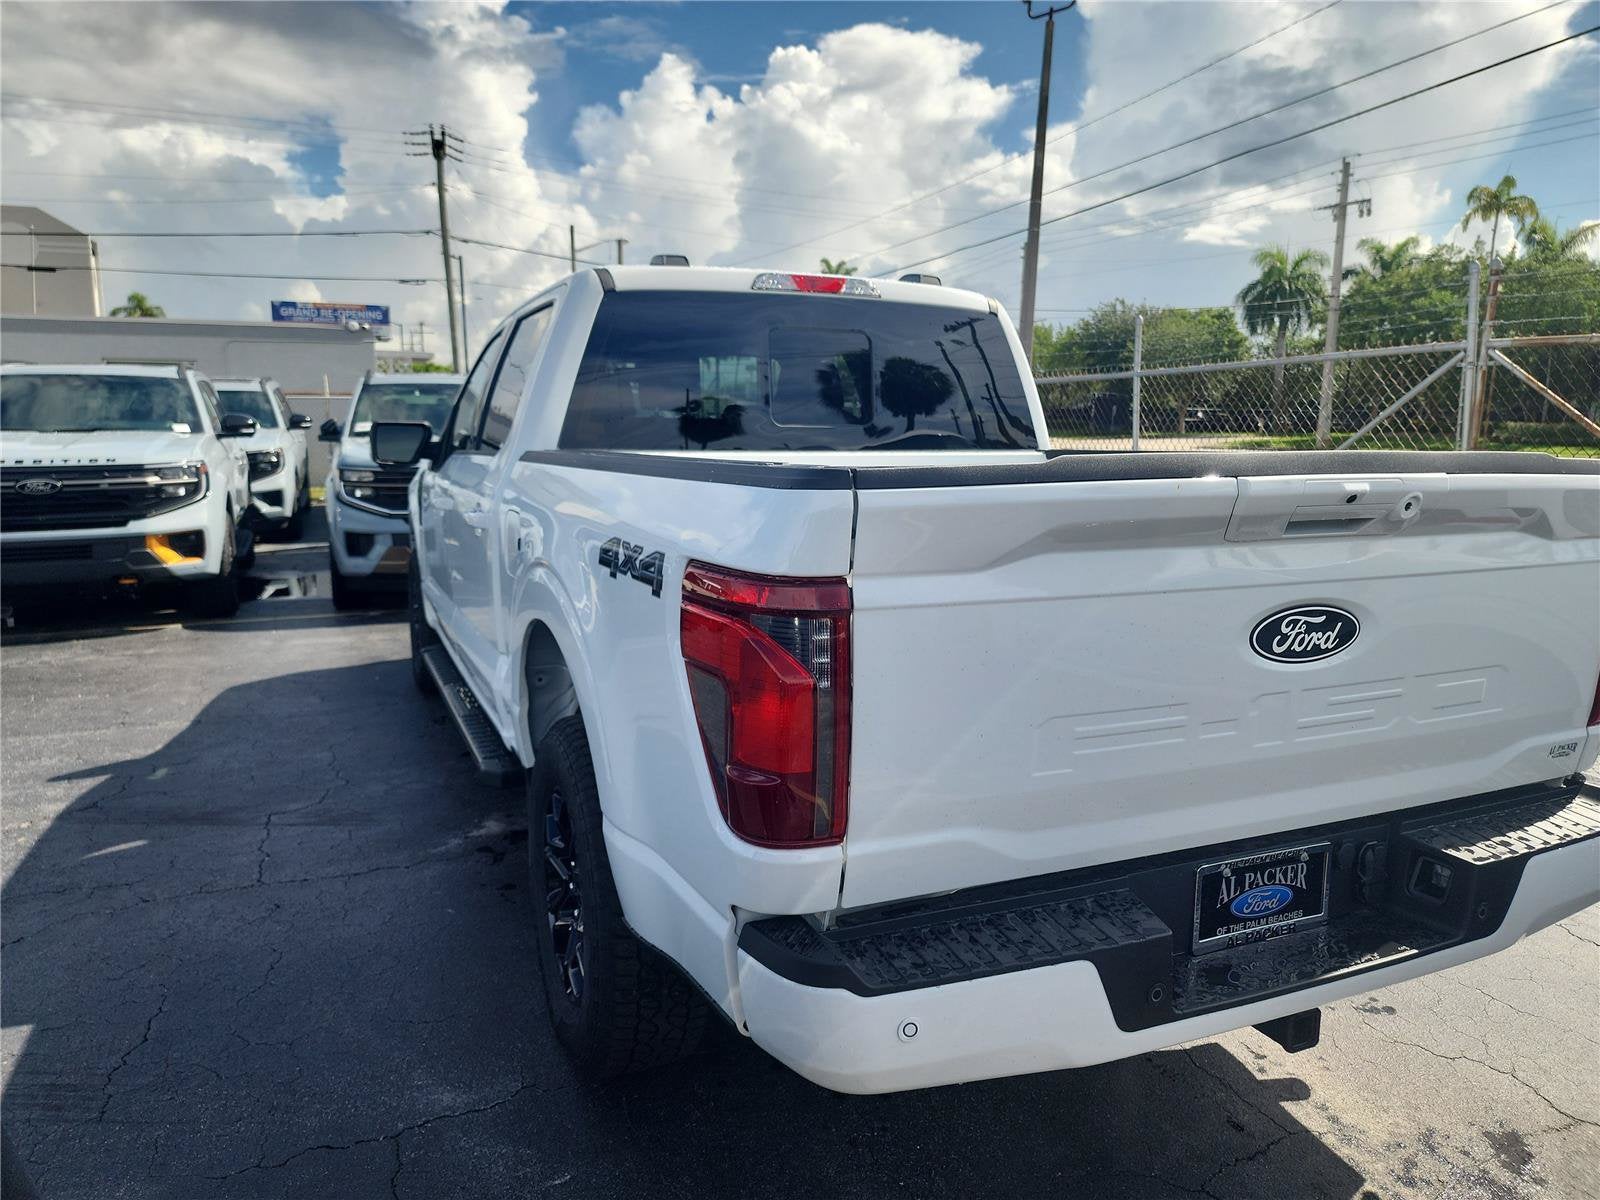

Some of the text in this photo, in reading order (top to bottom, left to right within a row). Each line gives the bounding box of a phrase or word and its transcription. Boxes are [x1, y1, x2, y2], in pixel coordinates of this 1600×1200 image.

[280, 306, 383, 320] GRAND RE-OPENING
[1272, 615, 1342, 653] Ford
[1032, 663, 1511, 776] F-150
[1216, 862, 1307, 908] AL PACKER
[1243, 892, 1281, 913] Ford
[1216, 910, 1303, 936] OF THE PALM BEACHES
[1226, 921, 1297, 949] AL PACKER
